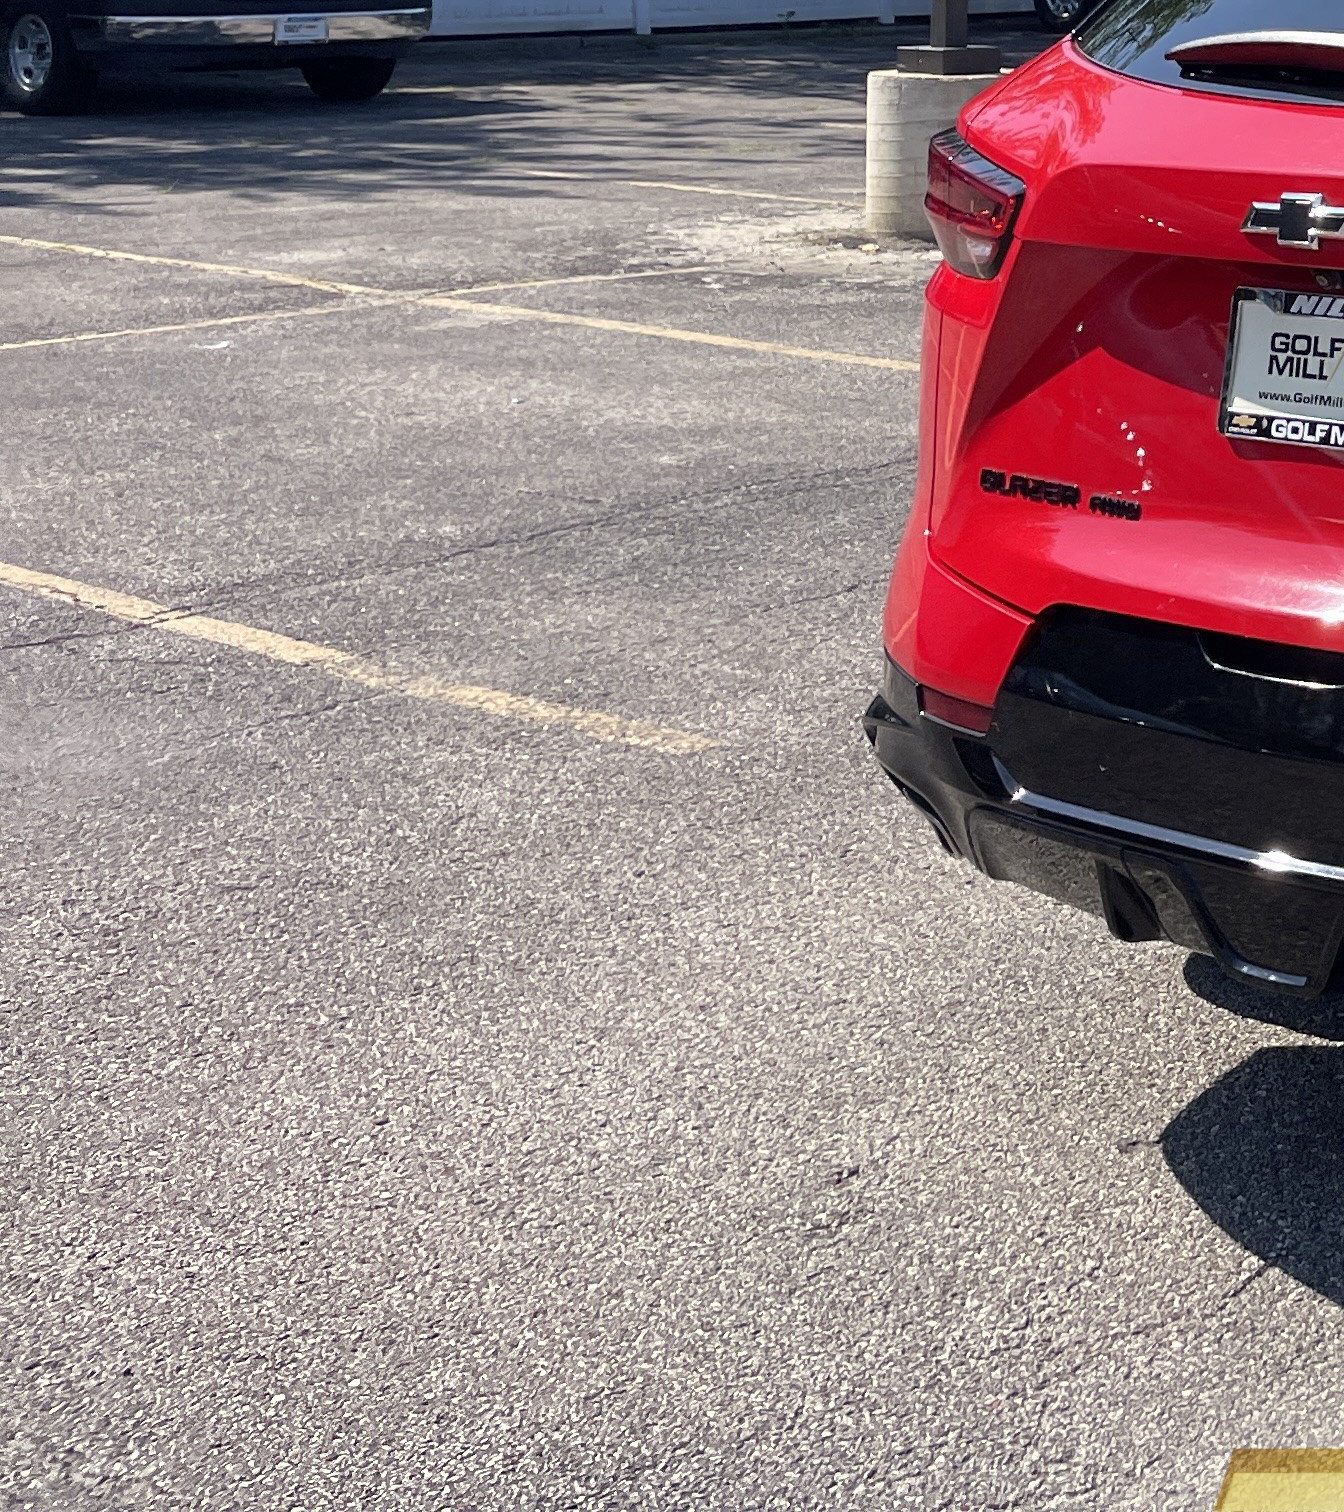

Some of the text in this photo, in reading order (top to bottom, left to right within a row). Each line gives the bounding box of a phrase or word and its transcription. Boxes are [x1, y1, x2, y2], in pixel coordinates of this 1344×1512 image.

[1267, 354, 1329, 381] MILL
[1271, 418, 1330, 442] GOLF
[980, 467, 1081, 510] BLAZER
